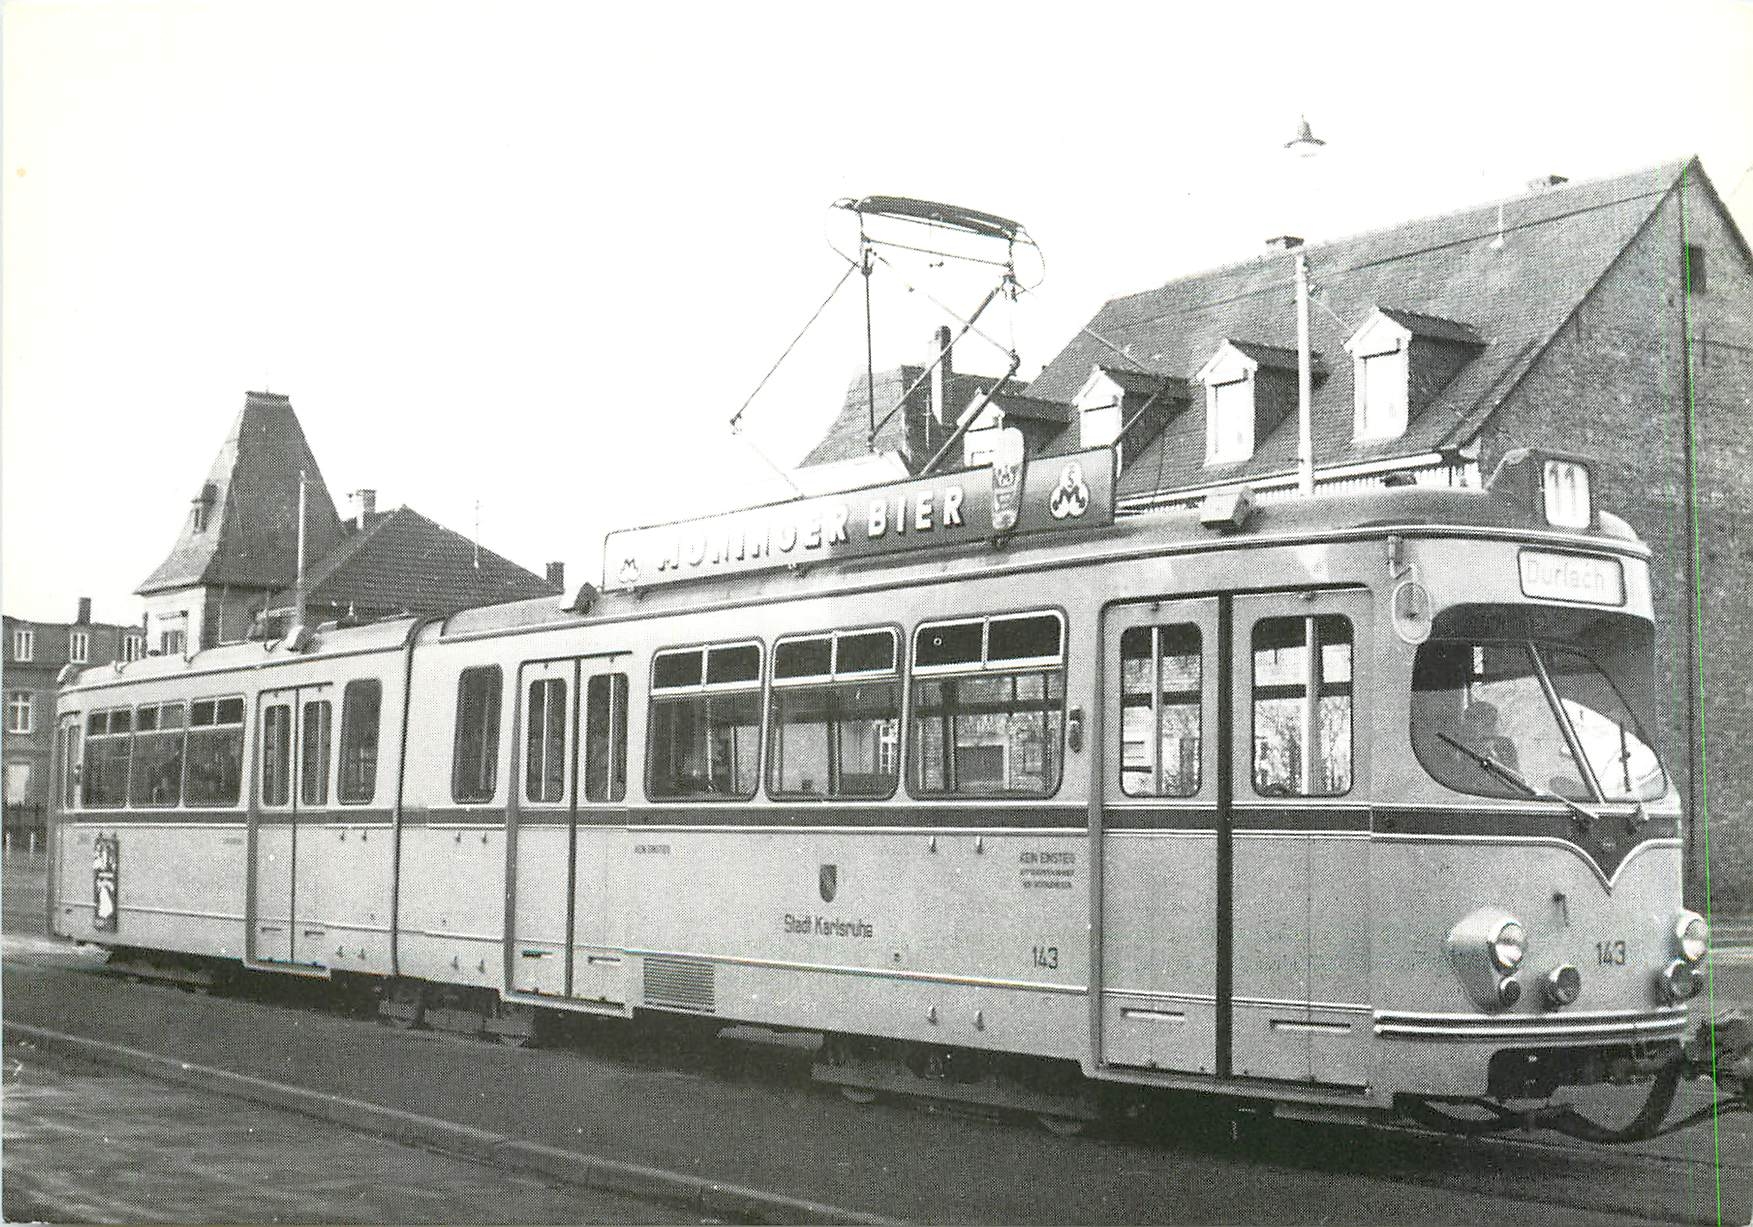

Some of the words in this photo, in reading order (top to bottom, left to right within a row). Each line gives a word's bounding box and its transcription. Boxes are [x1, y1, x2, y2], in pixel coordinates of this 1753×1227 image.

[868, 486, 964, 539] BIER
[1527, 558, 1605, 591] Durlach
[784, 913, 812, 934] Stadt
[814, 916, 873, 938] Karlsruhe
[1032, 946, 1059, 969] 143
[1596, 940, 1626, 965] 143
